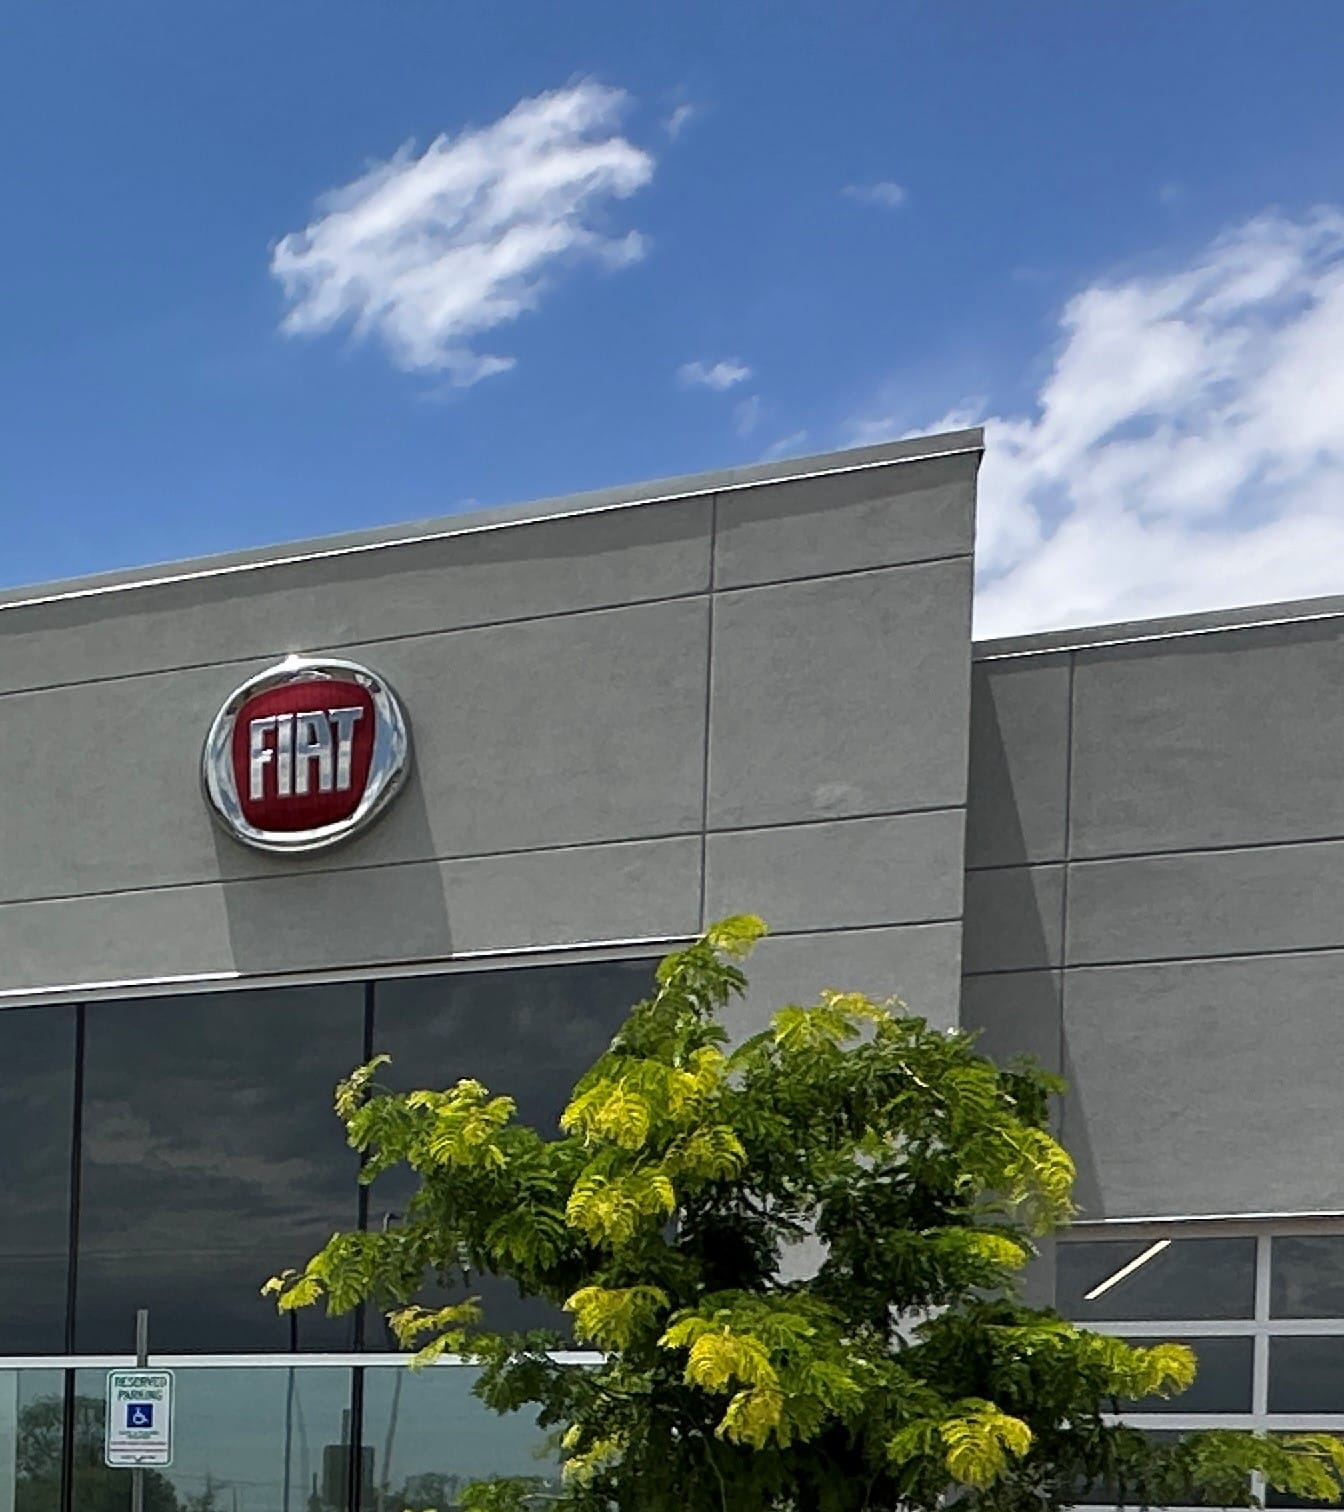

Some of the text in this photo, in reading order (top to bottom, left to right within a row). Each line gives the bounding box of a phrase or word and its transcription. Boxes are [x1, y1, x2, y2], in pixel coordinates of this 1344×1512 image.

[249, 706, 364, 800] FIAT
[113, 1376, 168, 1388] RESERVED
[117, 1390, 164, 1401] PARKING
